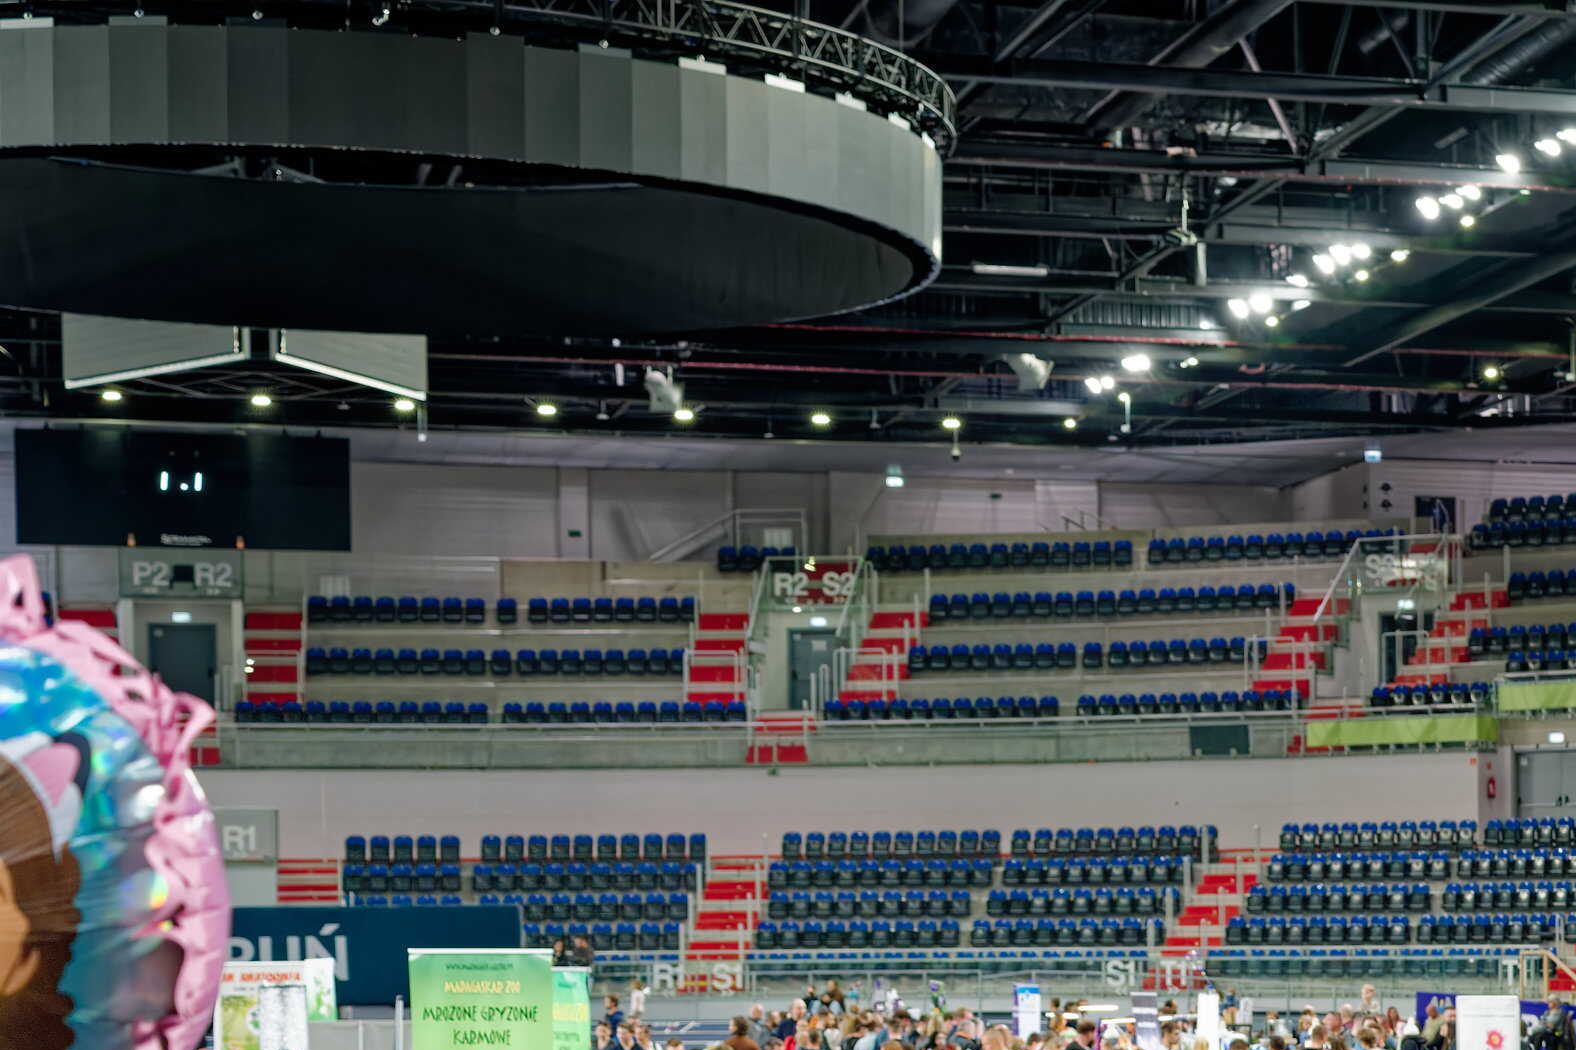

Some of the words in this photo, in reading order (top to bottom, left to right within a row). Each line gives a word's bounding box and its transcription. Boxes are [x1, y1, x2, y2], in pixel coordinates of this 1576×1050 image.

[132, 561, 170, 587] P2
[194, 562, 233, 587] R2
[774, 572, 809, 597] R2
[822, 571, 857, 597] S2
[222, 825, 256, 852] R1
[653, 963, 685, 990] R1
[712, 963, 743, 990] S1
[1106, 960, 1136, 986] S1
[1159, 961, 1187, 988] T1
[422, 1005, 478, 1022] MROZONE
[480, 1004, 539, 1023] GRYZONIE
[453, 1029, 512, 1046] KARMOWE
